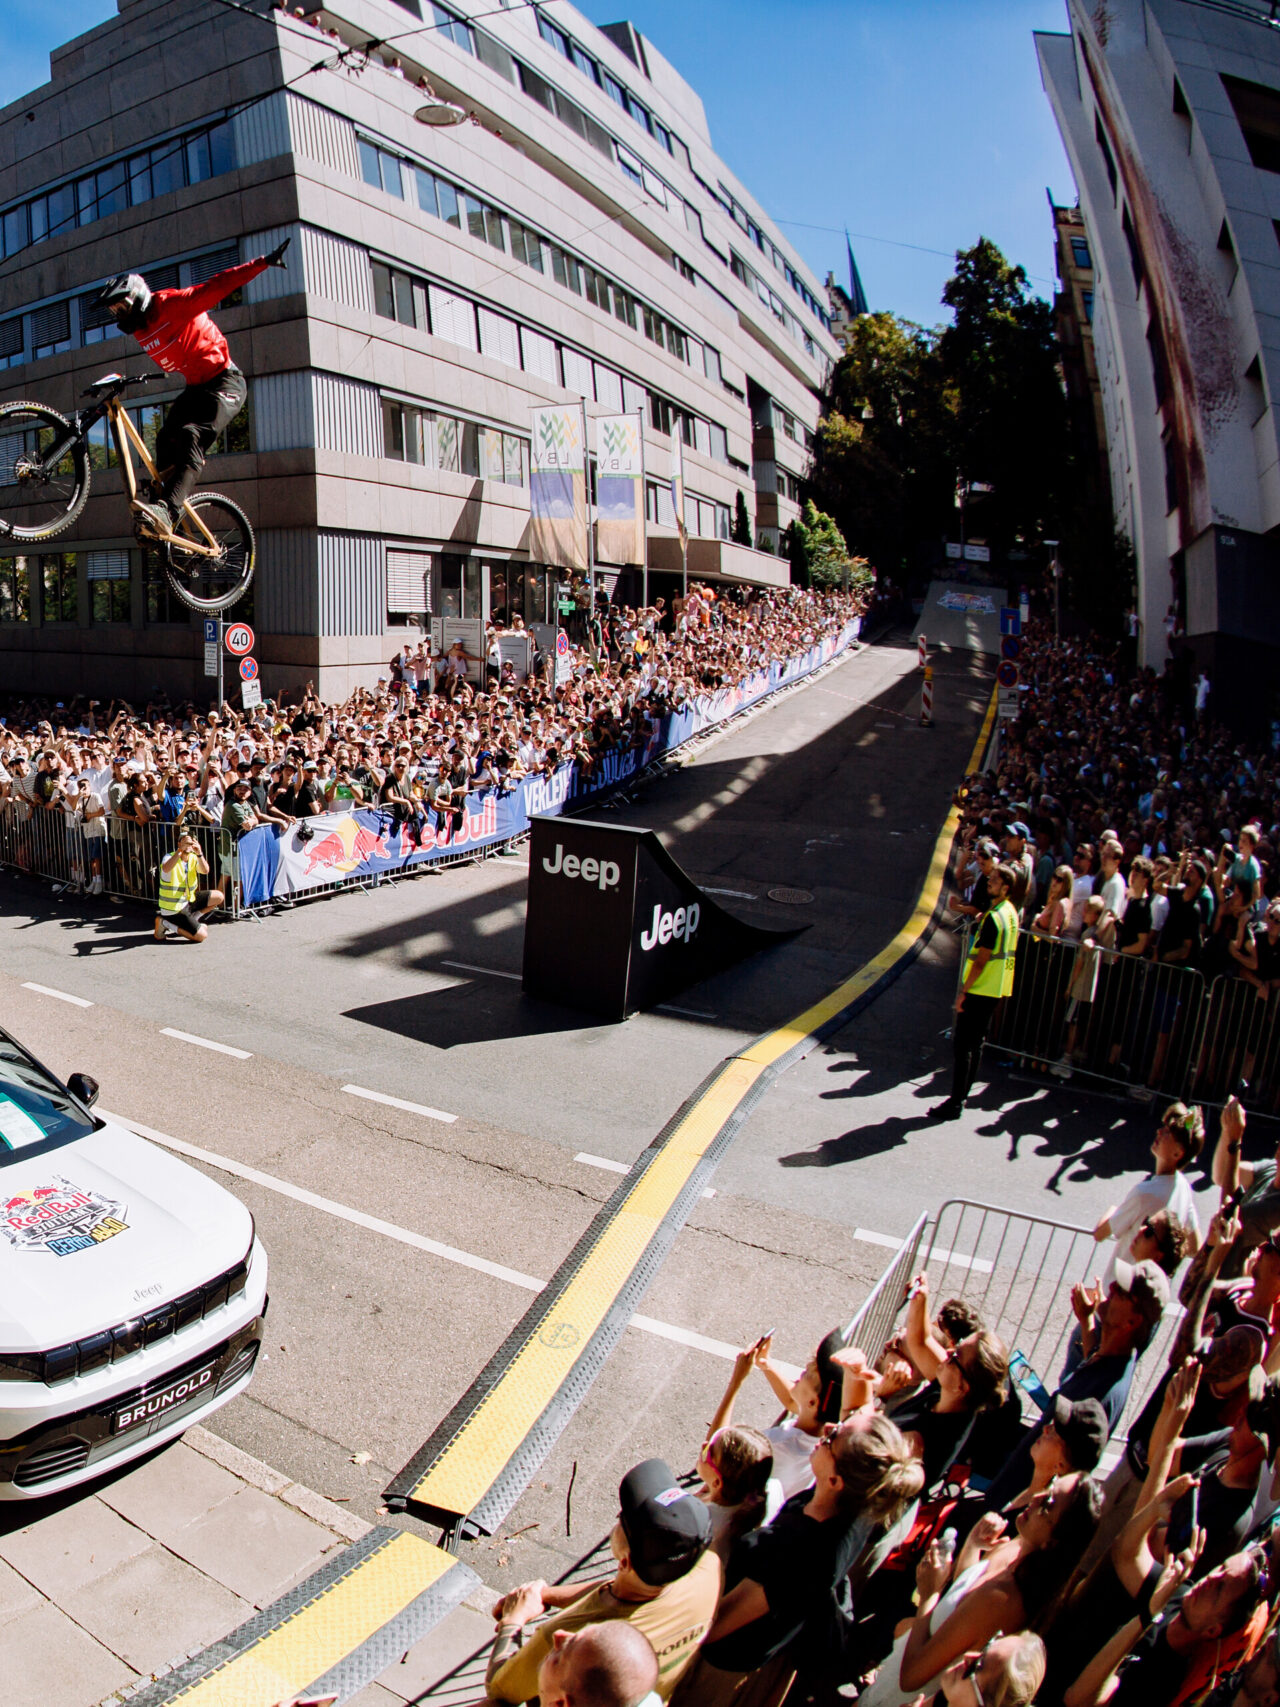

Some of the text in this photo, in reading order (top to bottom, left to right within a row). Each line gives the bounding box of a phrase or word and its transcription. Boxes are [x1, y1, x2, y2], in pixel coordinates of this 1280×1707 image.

[206, 622, 214, 639] P
[232, 632, 249, 646] 40
[542, 844, 621, 890] Jeep
[640, 902, 701, 951] Jeep
[7, 1192, 92, 1230] Red Bull
[32, 1206, 95, 1234] STUTTGART
[45, 1216, 130, 1257] CERRO ABAJO
[133, 1282, 163, 1301] Jeep
[119, 1370, 212, 1428] BRUNOLD
